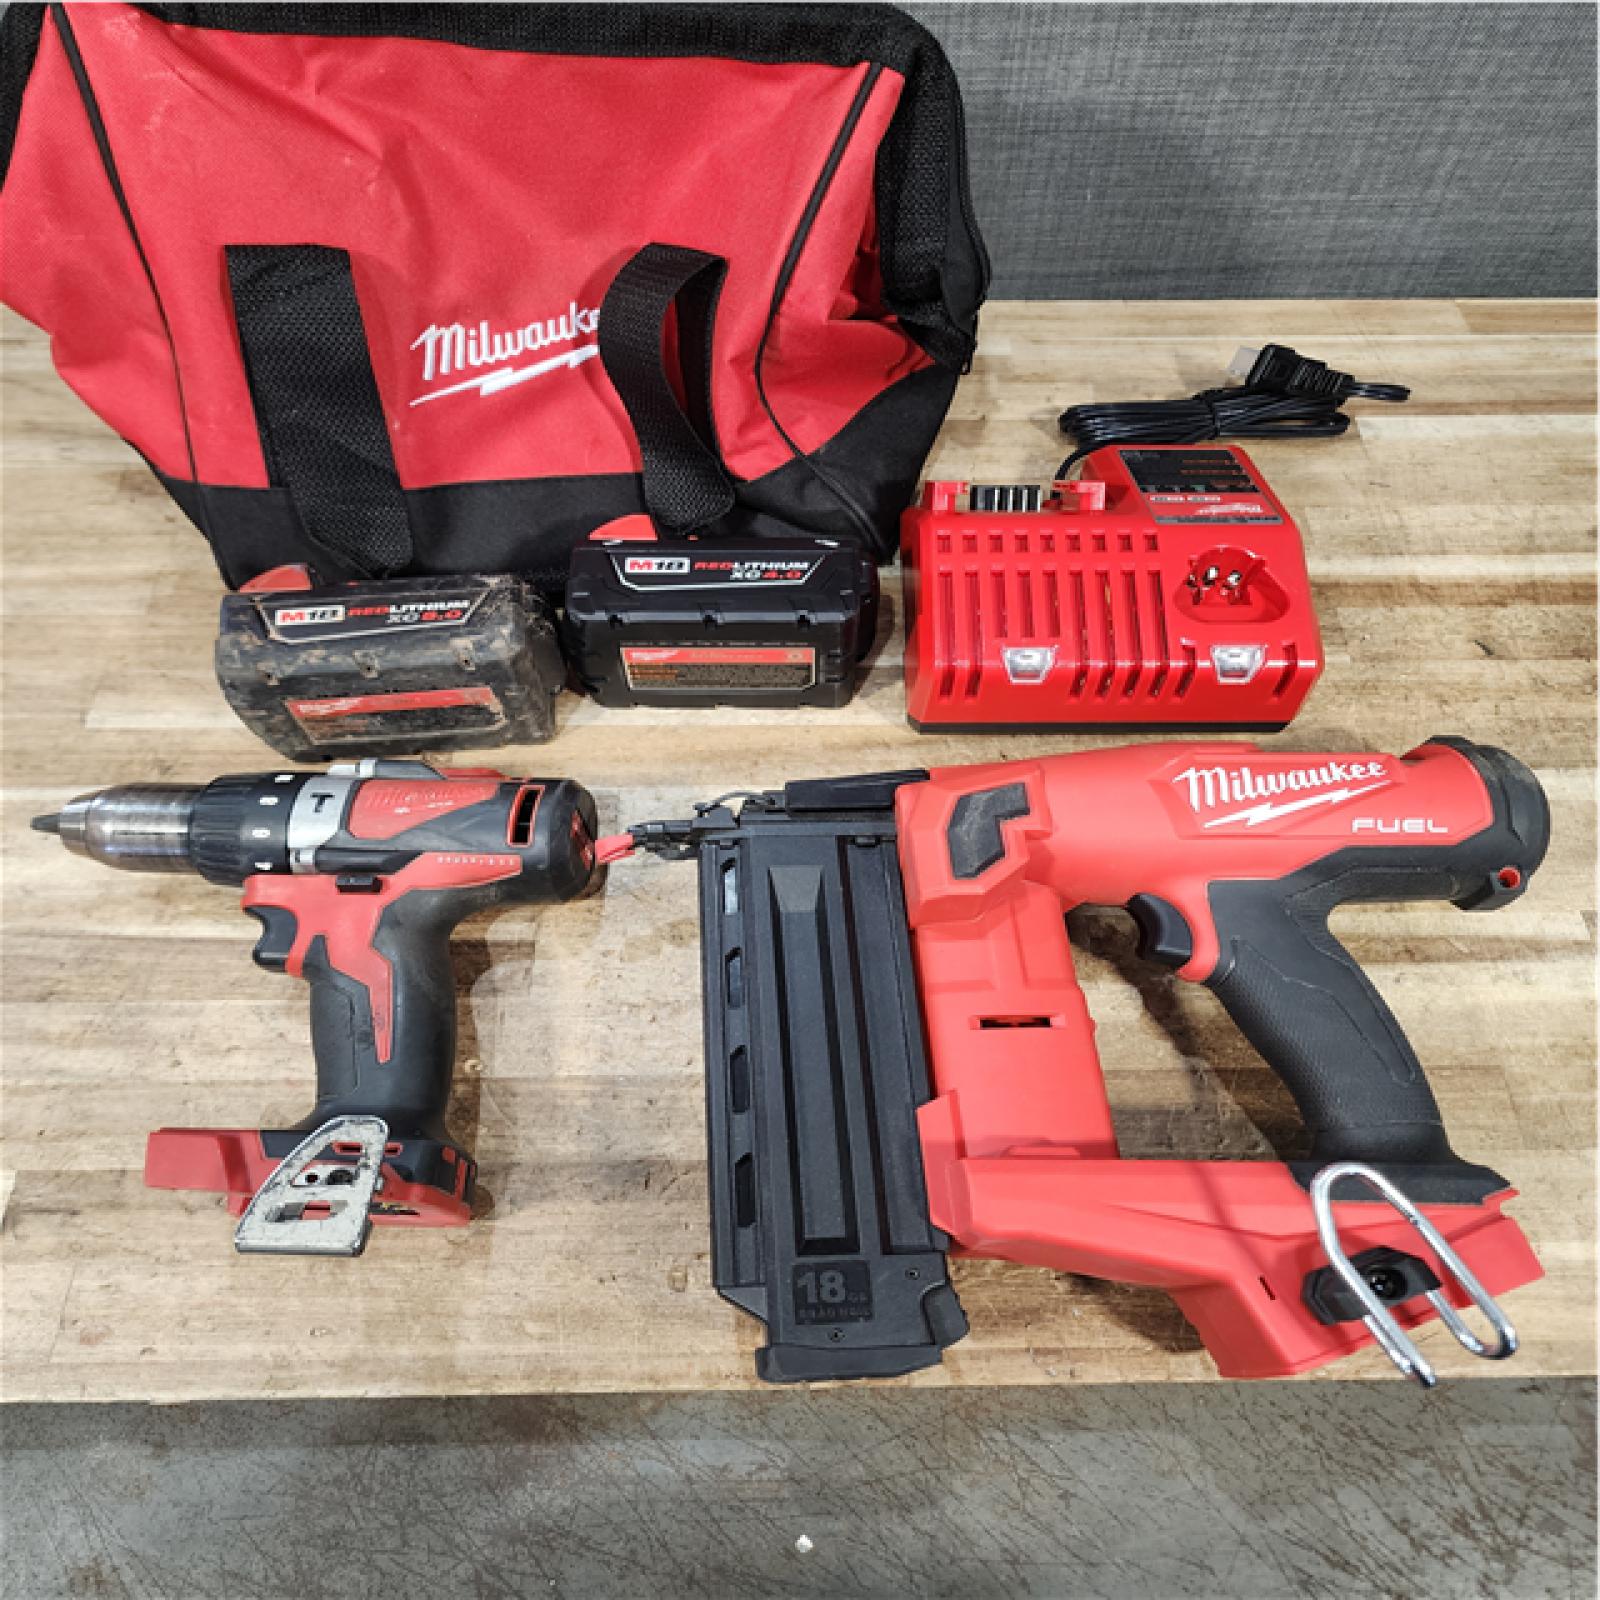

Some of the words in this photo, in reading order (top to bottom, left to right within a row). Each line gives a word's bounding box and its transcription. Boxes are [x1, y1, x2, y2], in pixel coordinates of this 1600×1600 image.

[629, 560, 685, 571] M18
[280, 607, 340, 624] M18
[1172, 761, 1388, 813] Milwaukee
[1351, 817, 1449, 834] FUEL
[796, 1269, 846, 1303] 18
